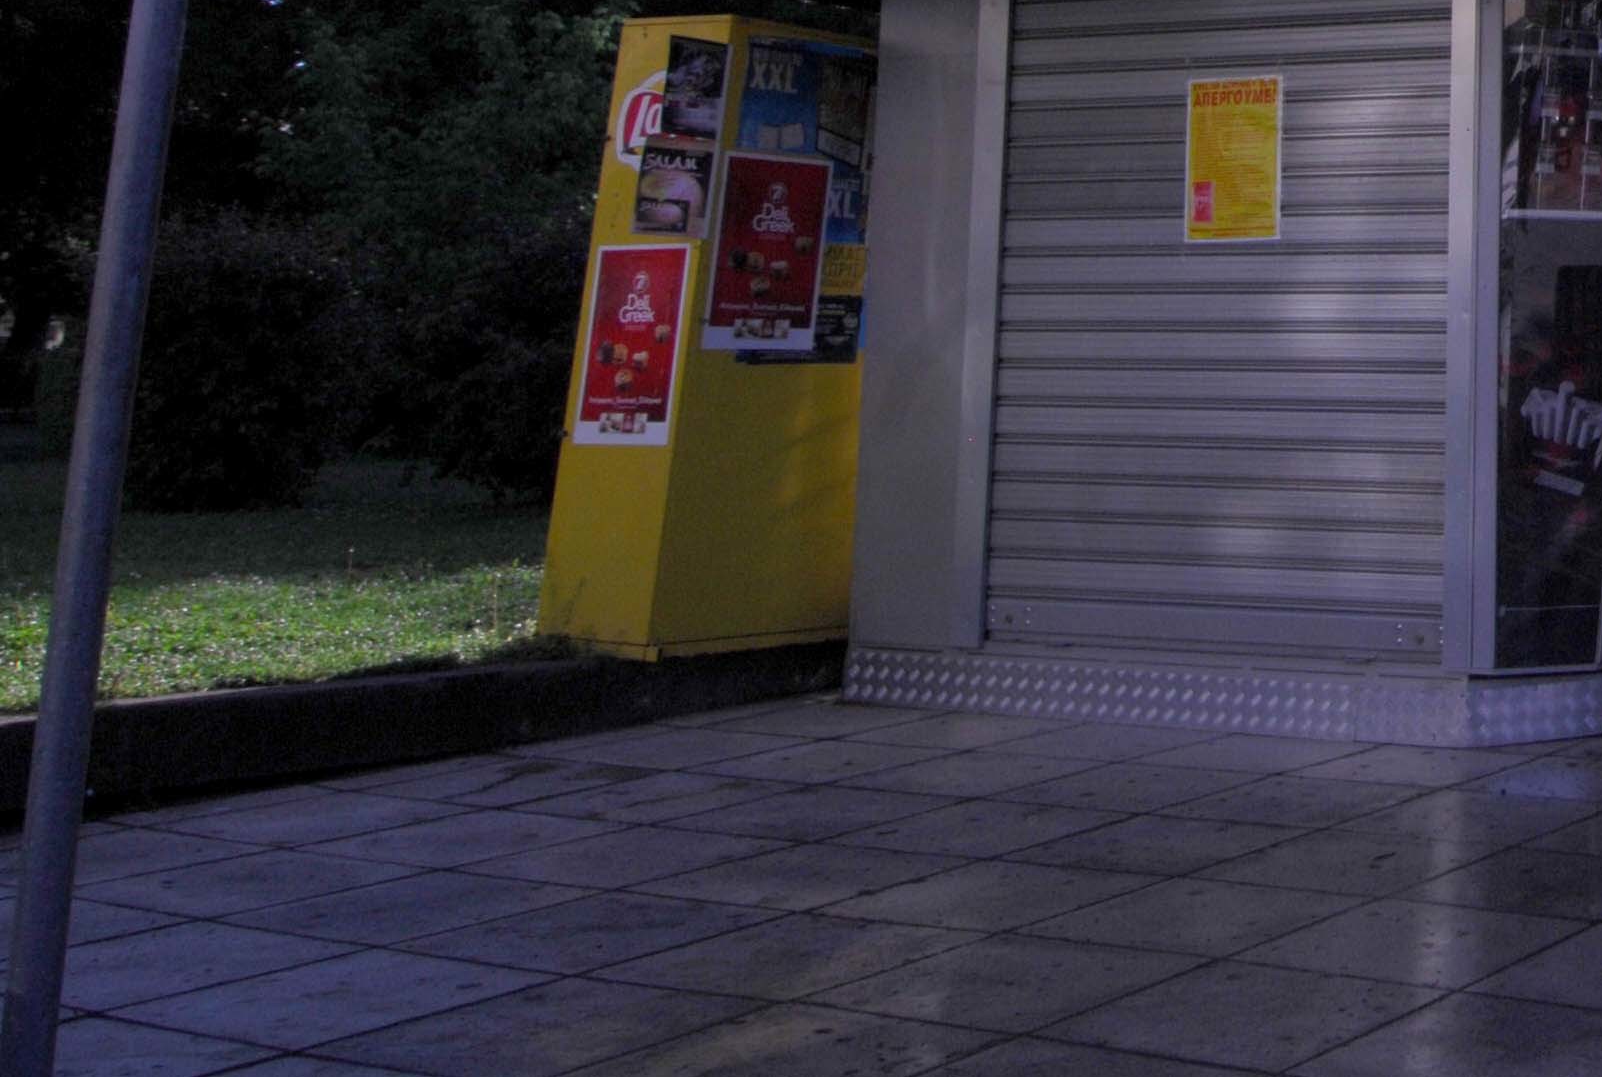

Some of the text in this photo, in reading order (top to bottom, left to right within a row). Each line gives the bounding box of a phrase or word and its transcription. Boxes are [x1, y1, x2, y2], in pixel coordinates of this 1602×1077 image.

[1193, 87, 1276, 108] ΑΠΕΡΓΟΥΜΕ!
[762, 203, 788, 220] Deli
[626, 294, 651, 310] Deli
